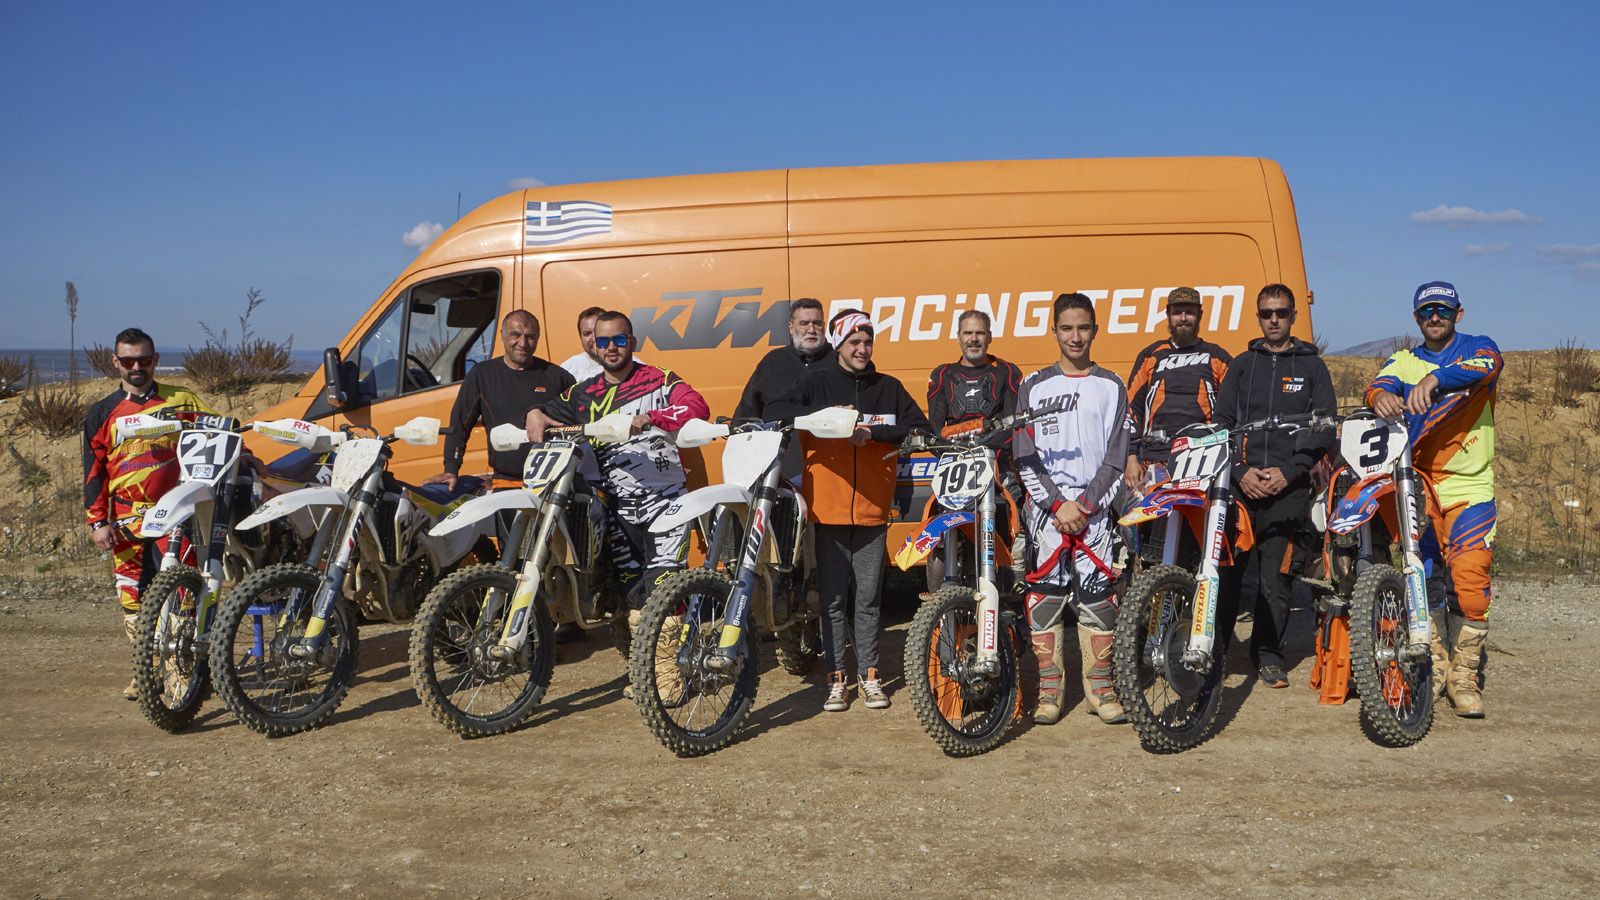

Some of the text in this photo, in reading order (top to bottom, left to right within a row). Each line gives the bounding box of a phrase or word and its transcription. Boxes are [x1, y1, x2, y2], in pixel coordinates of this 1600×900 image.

[634, 288, 790, 351] KTM
[1156, 352, 1210, 373] KTM
[124, 416, 141, 425] RK
[293, 421, 311, 431] RK
[181, 433, 228, 465] 21
[1171, 445, 1222, 482] 111
[1360, 426, 1389, 467] 3
[524, 451, 561, 480] 97
[939, 461, 987, 497] 192
[1212, 513, 1225, 560] SIX DAYS
[735, 594, 746, 619] Husqvarna
[1160, 594, 1171, 625] THENA
[1196, 584, 1206, 632] DUNLOP
[1208, 580, 1219, 624] MOTOREX
[985, 611, 994, 649] MOTUL
